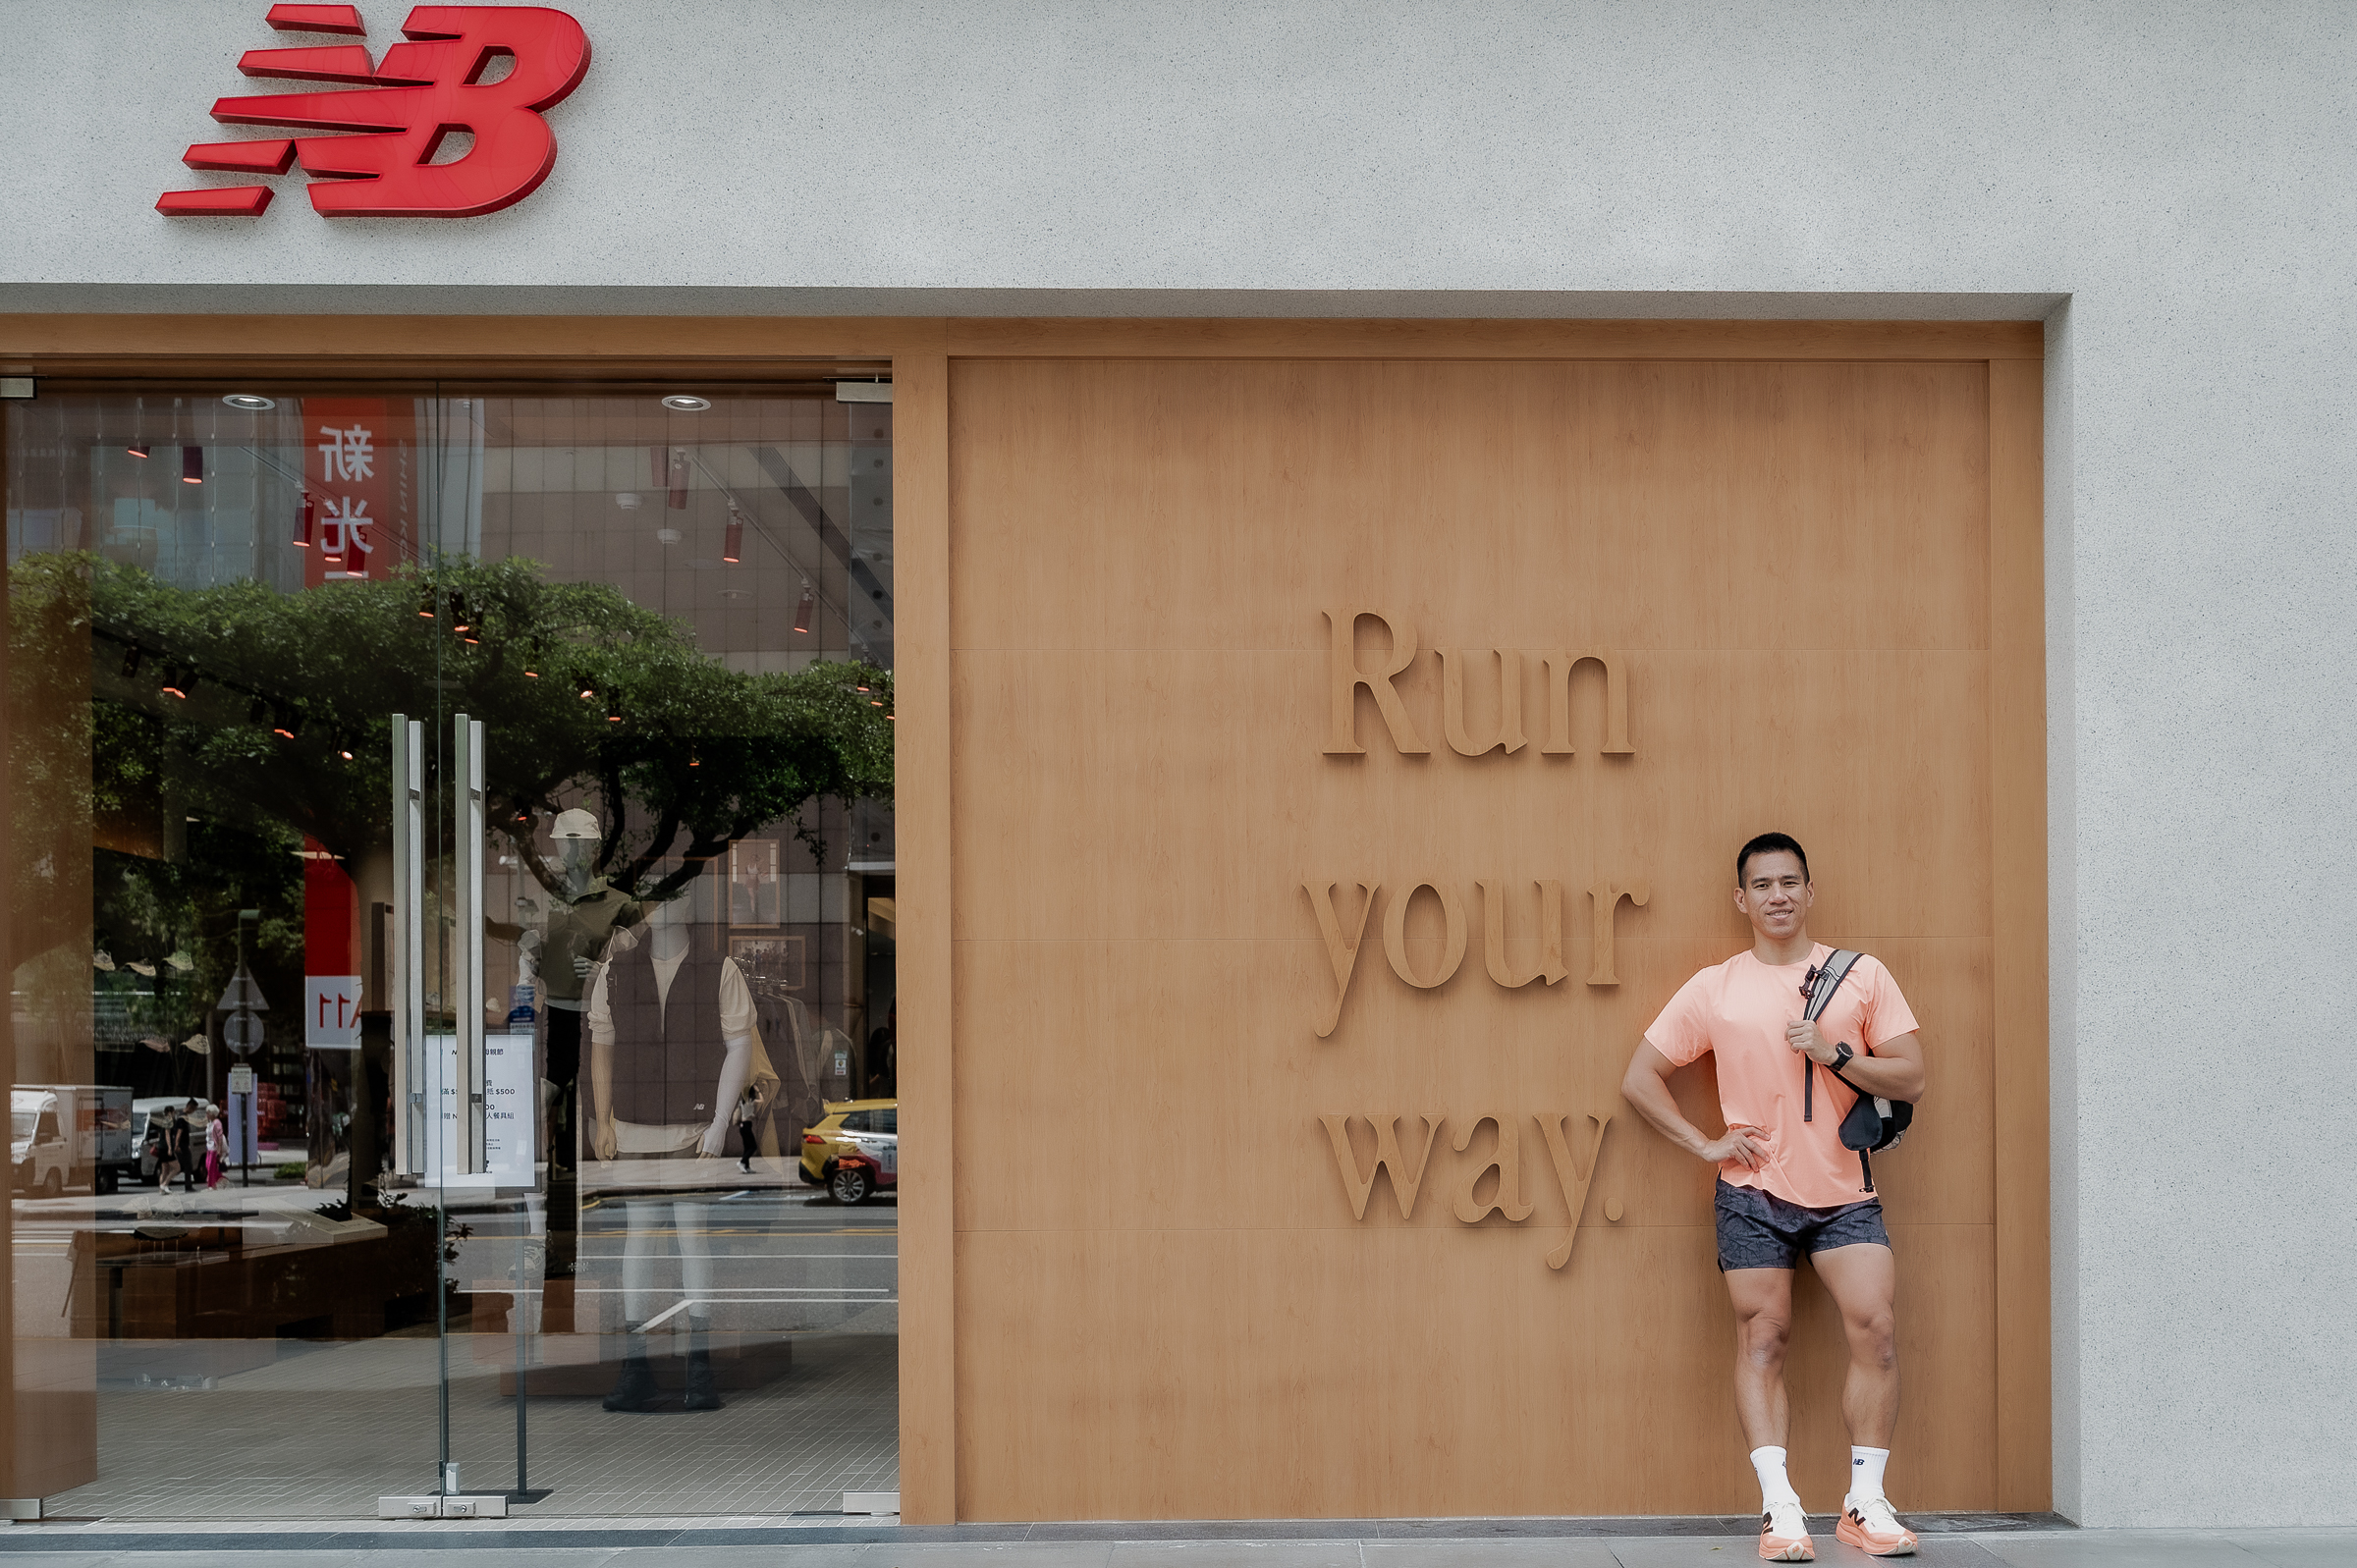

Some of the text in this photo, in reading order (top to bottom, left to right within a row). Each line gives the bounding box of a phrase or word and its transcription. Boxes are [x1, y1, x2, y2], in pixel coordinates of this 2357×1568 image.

[1321, 609, 1637, 757] Run
[1301, 879, 1651, 1038] your
[1317, 1112, 1624, 1271] way.
